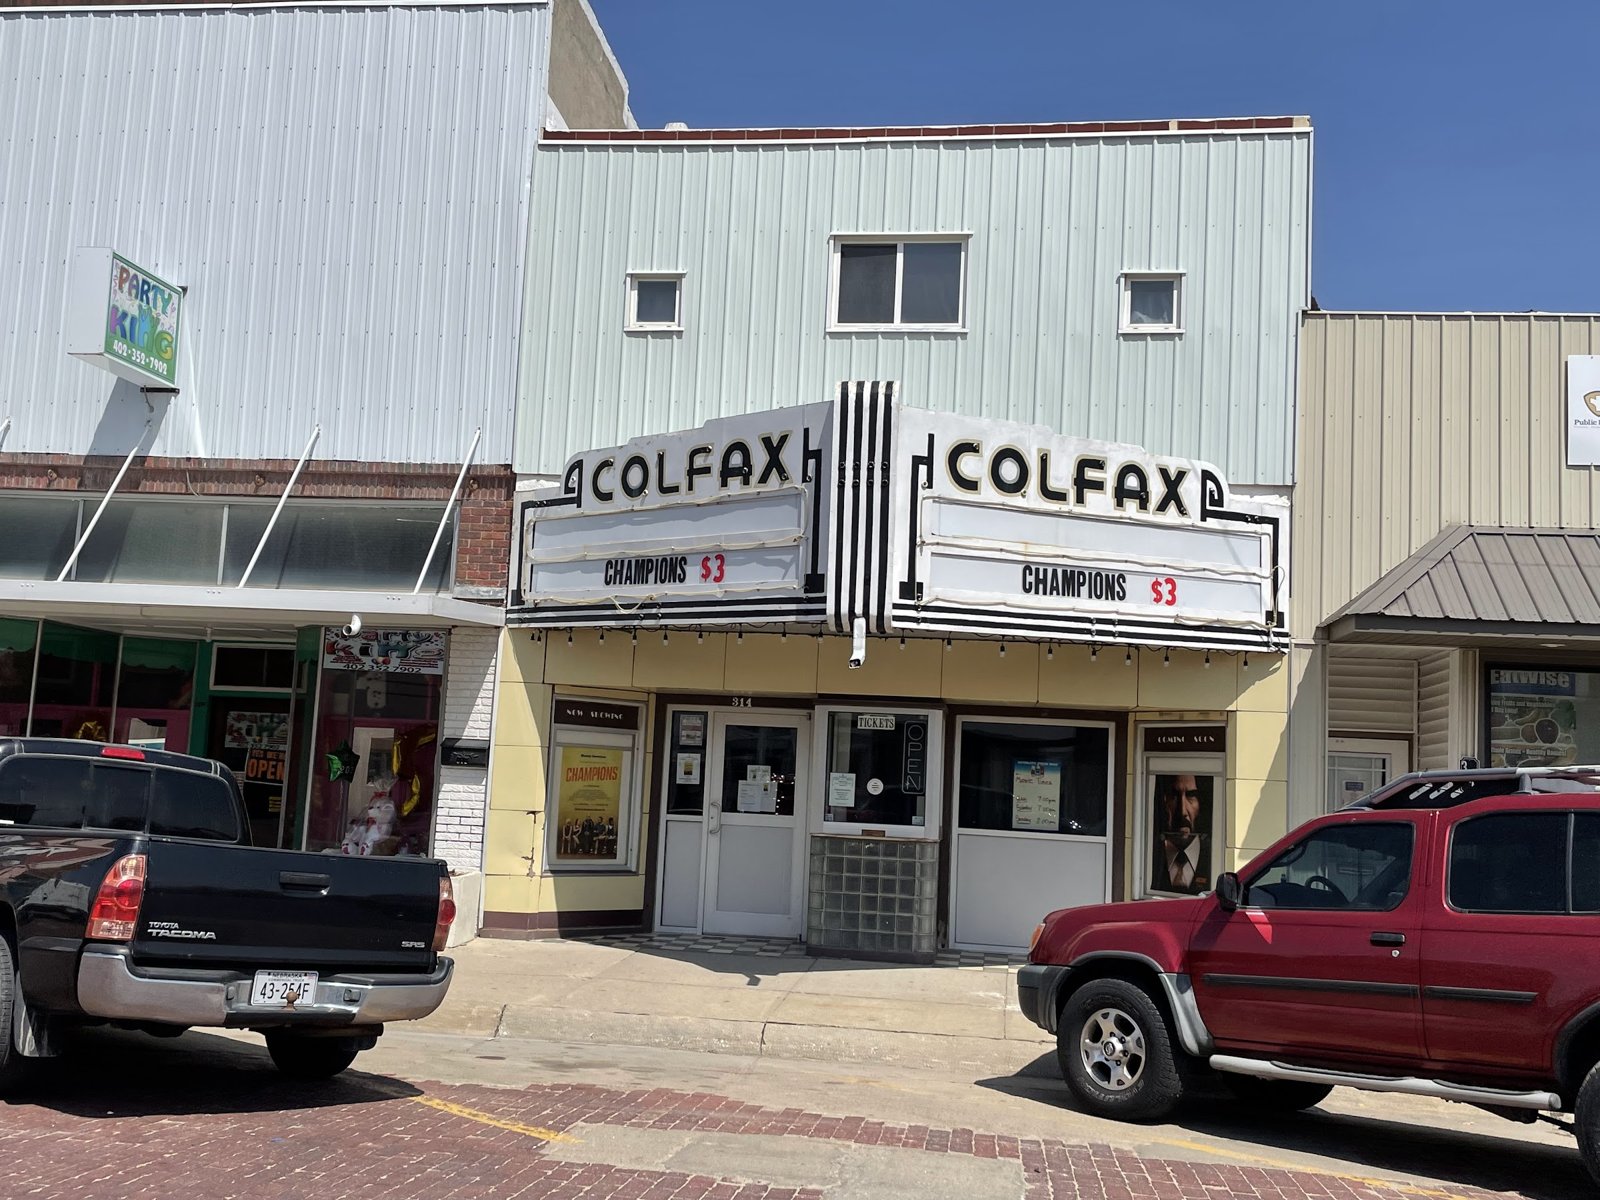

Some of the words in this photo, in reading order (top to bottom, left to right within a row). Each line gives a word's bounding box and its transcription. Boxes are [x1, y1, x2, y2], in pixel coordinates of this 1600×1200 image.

[118, 264, 172, 315] PARTY
[110, 304, 173, 361] KING
[591, 430, 793, 503] COLFAX
[945, 438, 1191, 517] COLFAX
[604, 556, 687, 586] CHAMPIONS
[701, 553, 725, 584] $3
[1022, 564, 1127, 601] CHAMPIONS
[1151, 577, 1177, 607] $3
[591, 711, 623, 720] SHOWING
[732, 697, 752, 707] 314
[859, 717, 894, 728] TICKETS
[247, 759, 285, 781] OPEN
[907, 724, 924, 791] OPEN
[566, 766, 618, 782] CHAMPIONS
[147, 929, 217, 939] TACOMA
[260, 982, 310, 1000] 43-254F
